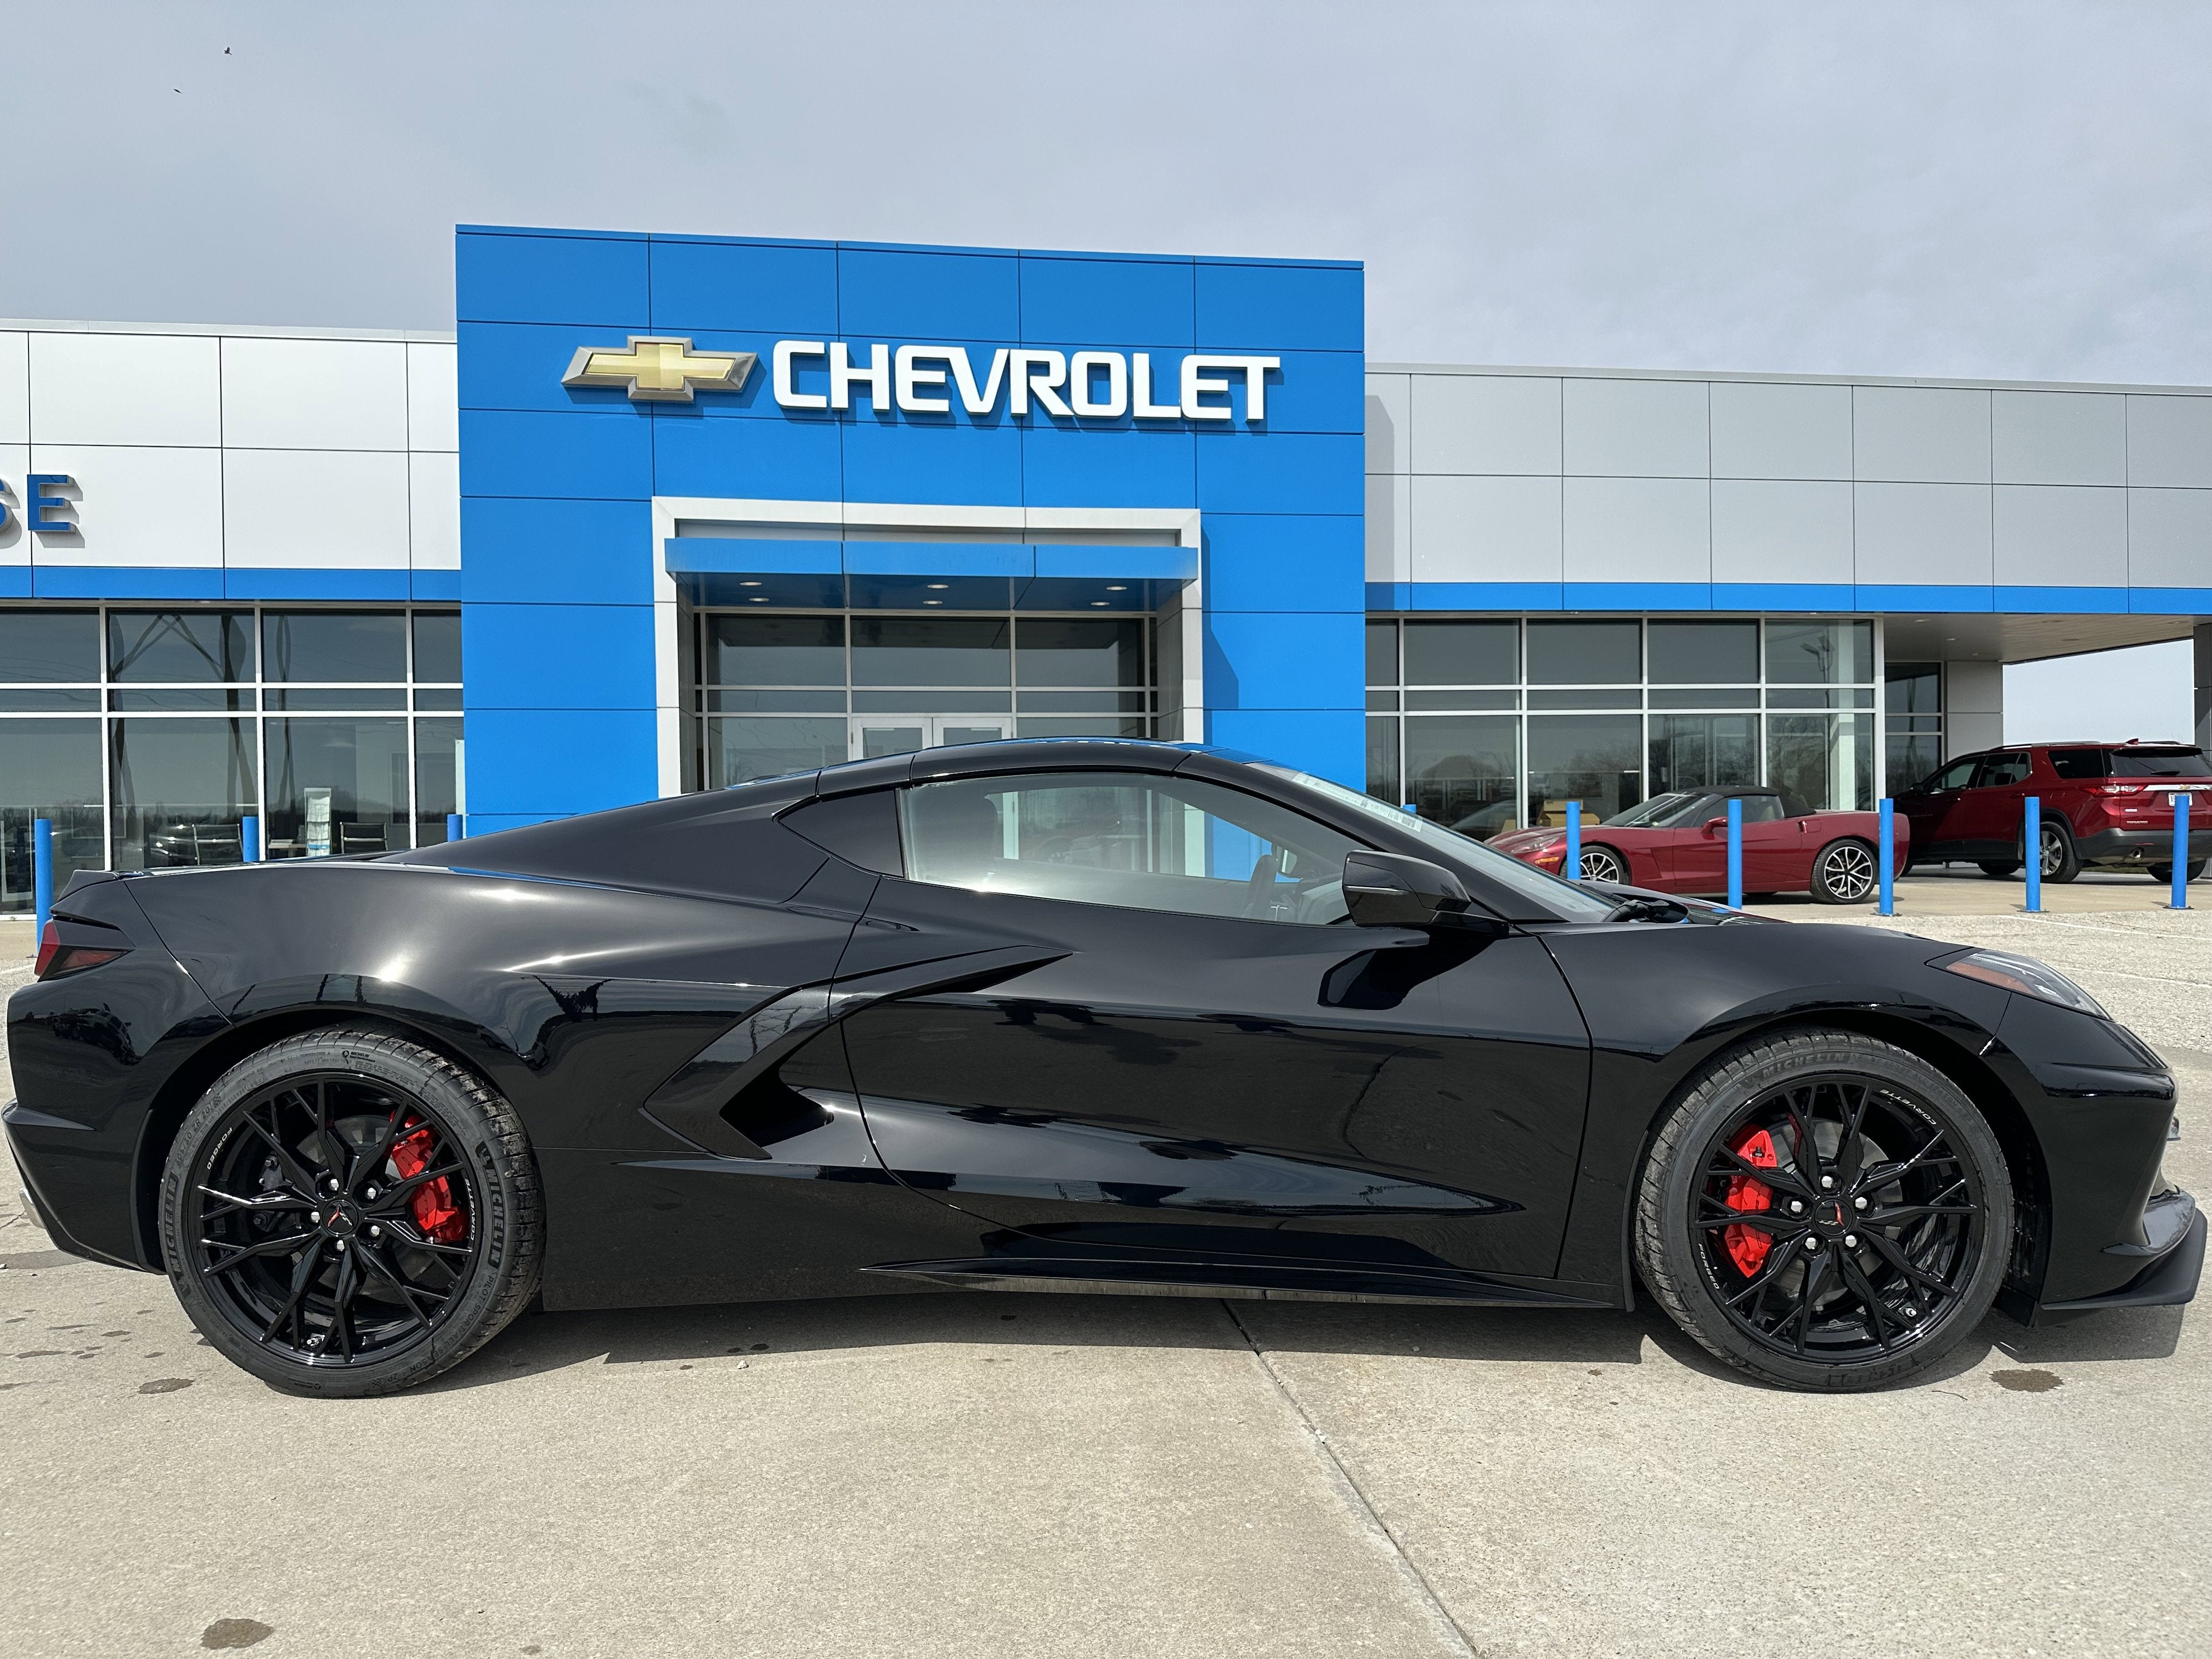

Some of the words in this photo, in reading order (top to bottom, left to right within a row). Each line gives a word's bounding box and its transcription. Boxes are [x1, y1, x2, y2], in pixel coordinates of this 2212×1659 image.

[773, 340, 1281, 422] CHEVROLET
[1762, 1052, 1845, 1078] MICHELIN
[193, 1118, 201, 1132] ZR
[1880, 1089, 1937, 1125] CORVETTE
[206, 1127, 233, 1170] FORGED
[165, 1178, 181, 1272] MICHELIN
[464, 1178, 476, 1241] CORVETTE
[486, 1169, 504, 1263] MICHELIN
[1698, 1243, 1720, 1290] FORGED
[477, 1274, 495, 1302] PILOT
[458, 1302, 482, 1333] SPORT
[443, 1330, 460, 1348] ALL
[408, 1346, 444, 1373] SEASON
